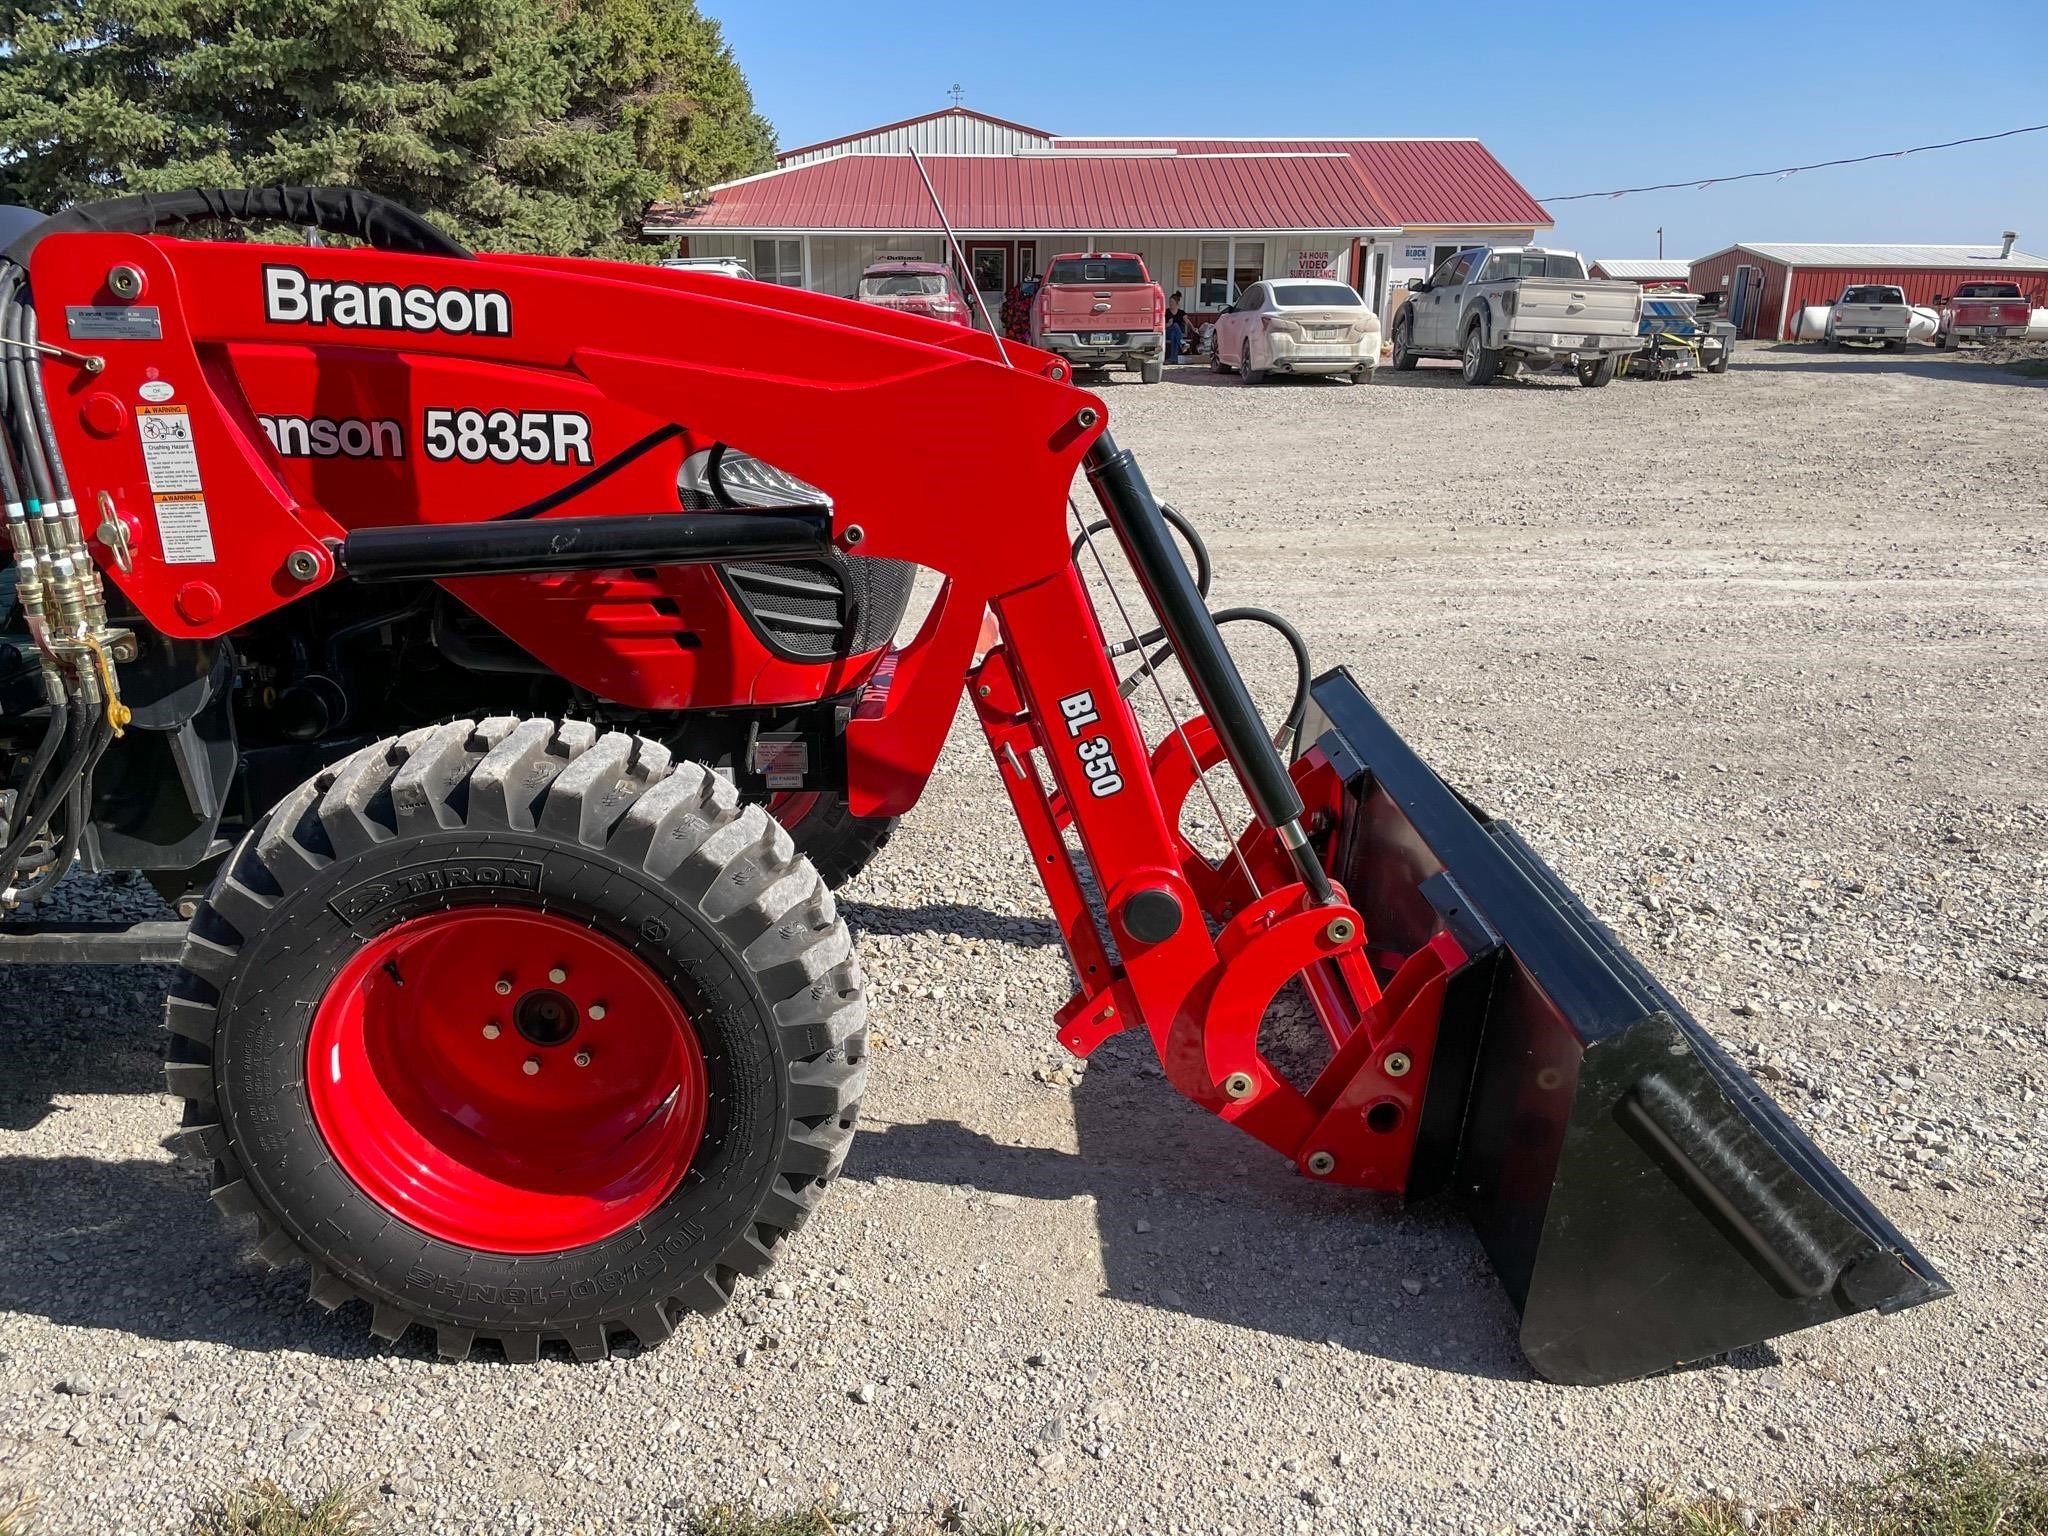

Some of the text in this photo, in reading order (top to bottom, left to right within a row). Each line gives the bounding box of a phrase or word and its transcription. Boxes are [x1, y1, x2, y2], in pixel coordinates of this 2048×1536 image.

[1405, 249, 1427, 257] BLOCK
[1289, 269, 1336, 278] SURVEILLANCE
[1299, 260, 1328, 269] VIDEO
[264, 266, 511, 336] Branson
[1053, 316, 1152, 325] RANGER
[426, 409, 593, 464] 5835R
[1059, 690, 1122, 797] BL 350
[397, 865, 532, 893] TIRON
